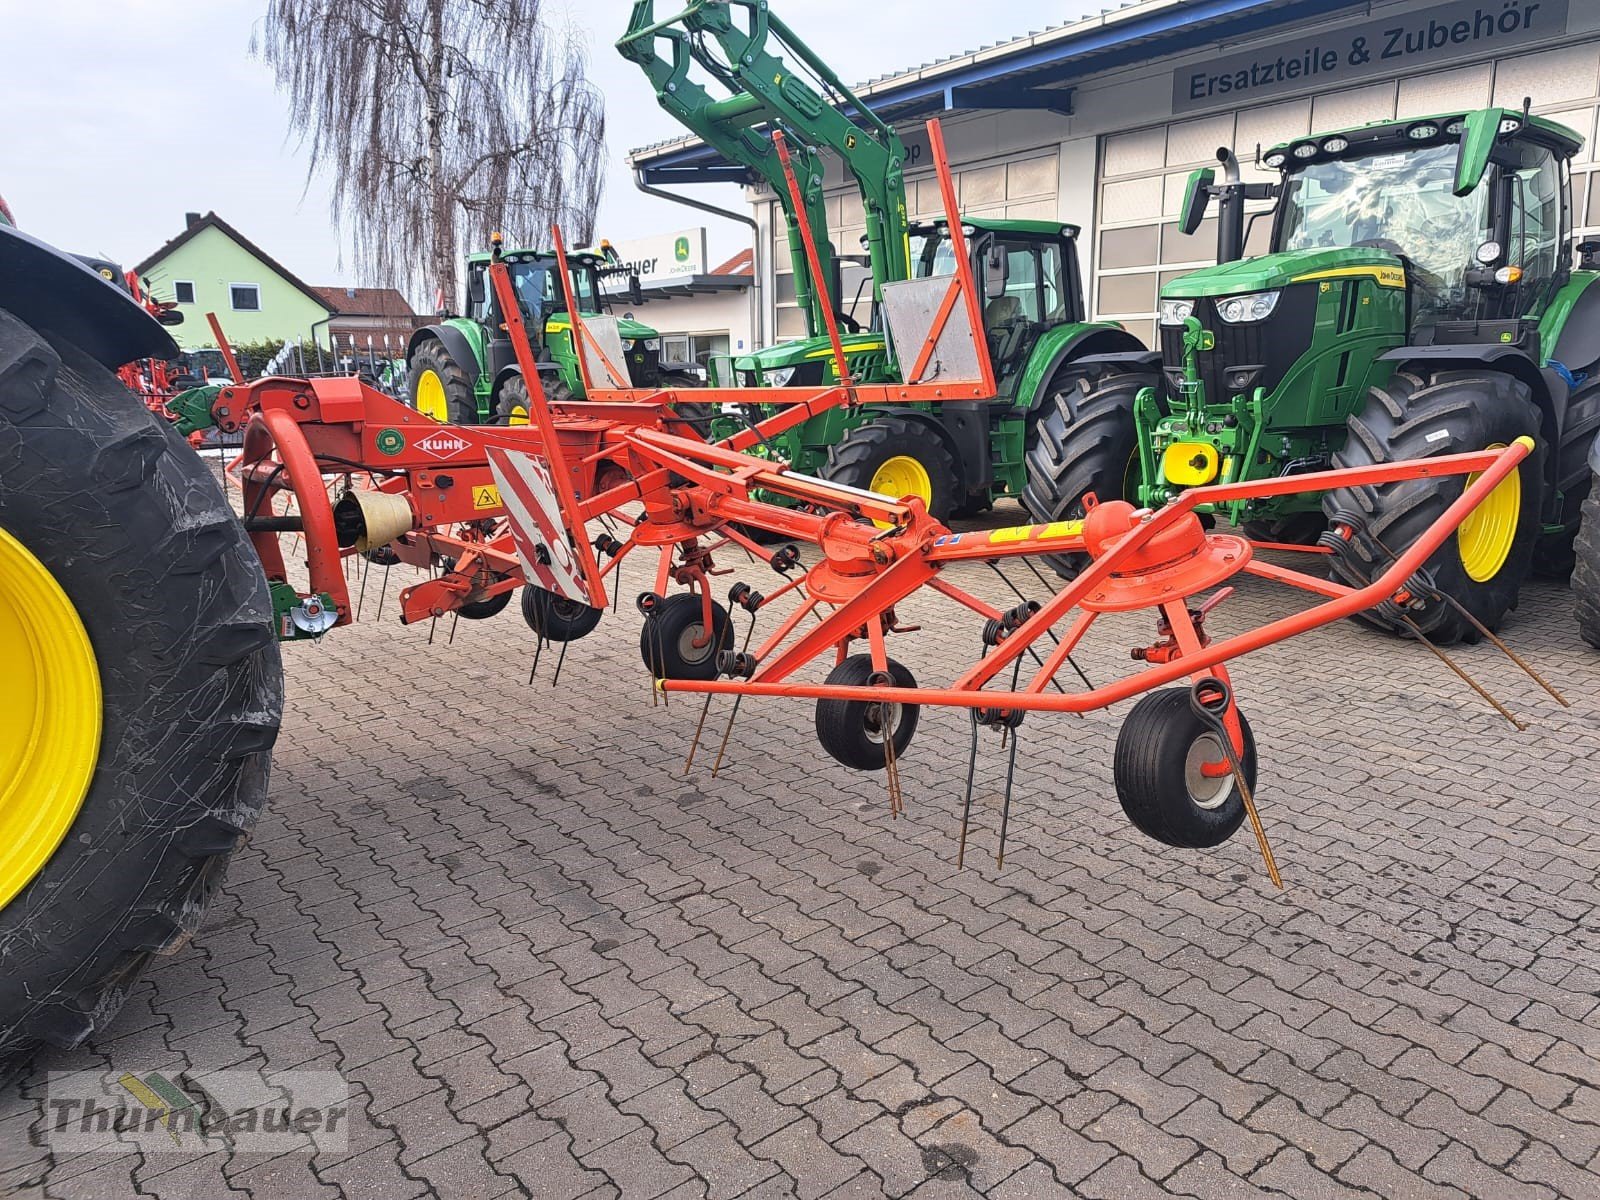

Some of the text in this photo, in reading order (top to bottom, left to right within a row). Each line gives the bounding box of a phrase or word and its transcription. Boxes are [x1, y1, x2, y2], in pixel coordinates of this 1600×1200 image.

[1190, 1, 1540, 100] Ersatzteile & Zubehör
[422, 440, 463, 450] KUHN
